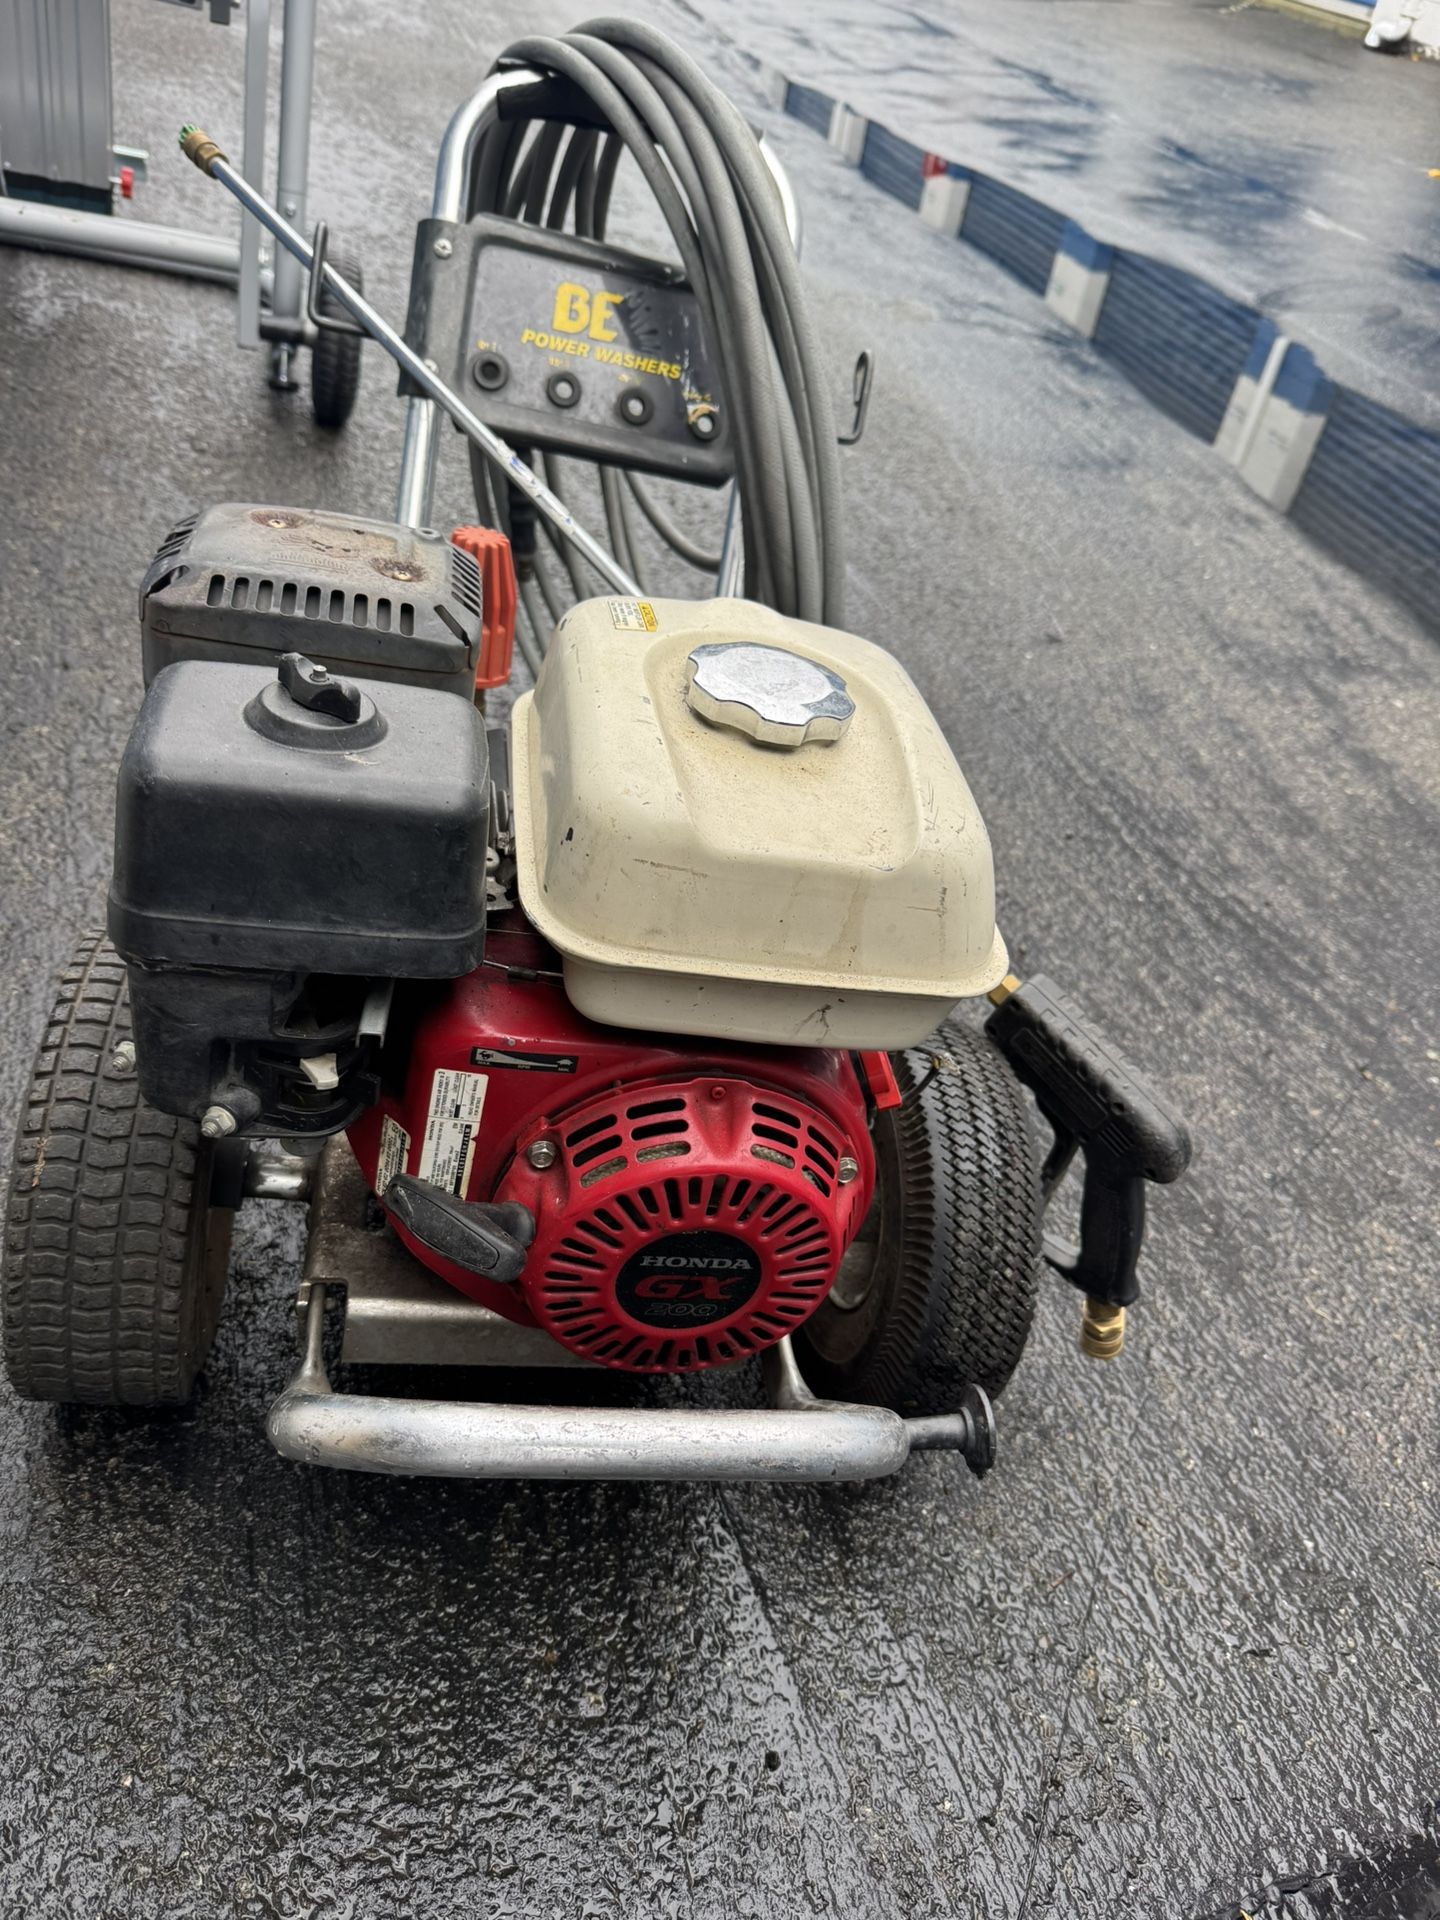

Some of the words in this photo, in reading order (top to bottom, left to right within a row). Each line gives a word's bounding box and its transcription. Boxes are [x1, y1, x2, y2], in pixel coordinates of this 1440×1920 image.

[552, 282, 624, 342] BE
[521, 329, 589, 358] POWER
[595, 348, 682, 379] WASHERS
[640, 1256, 752, 1269] HONDA
[636, 1275, 743, 1299] GX
[645, 1303, 718, 1316] 200
